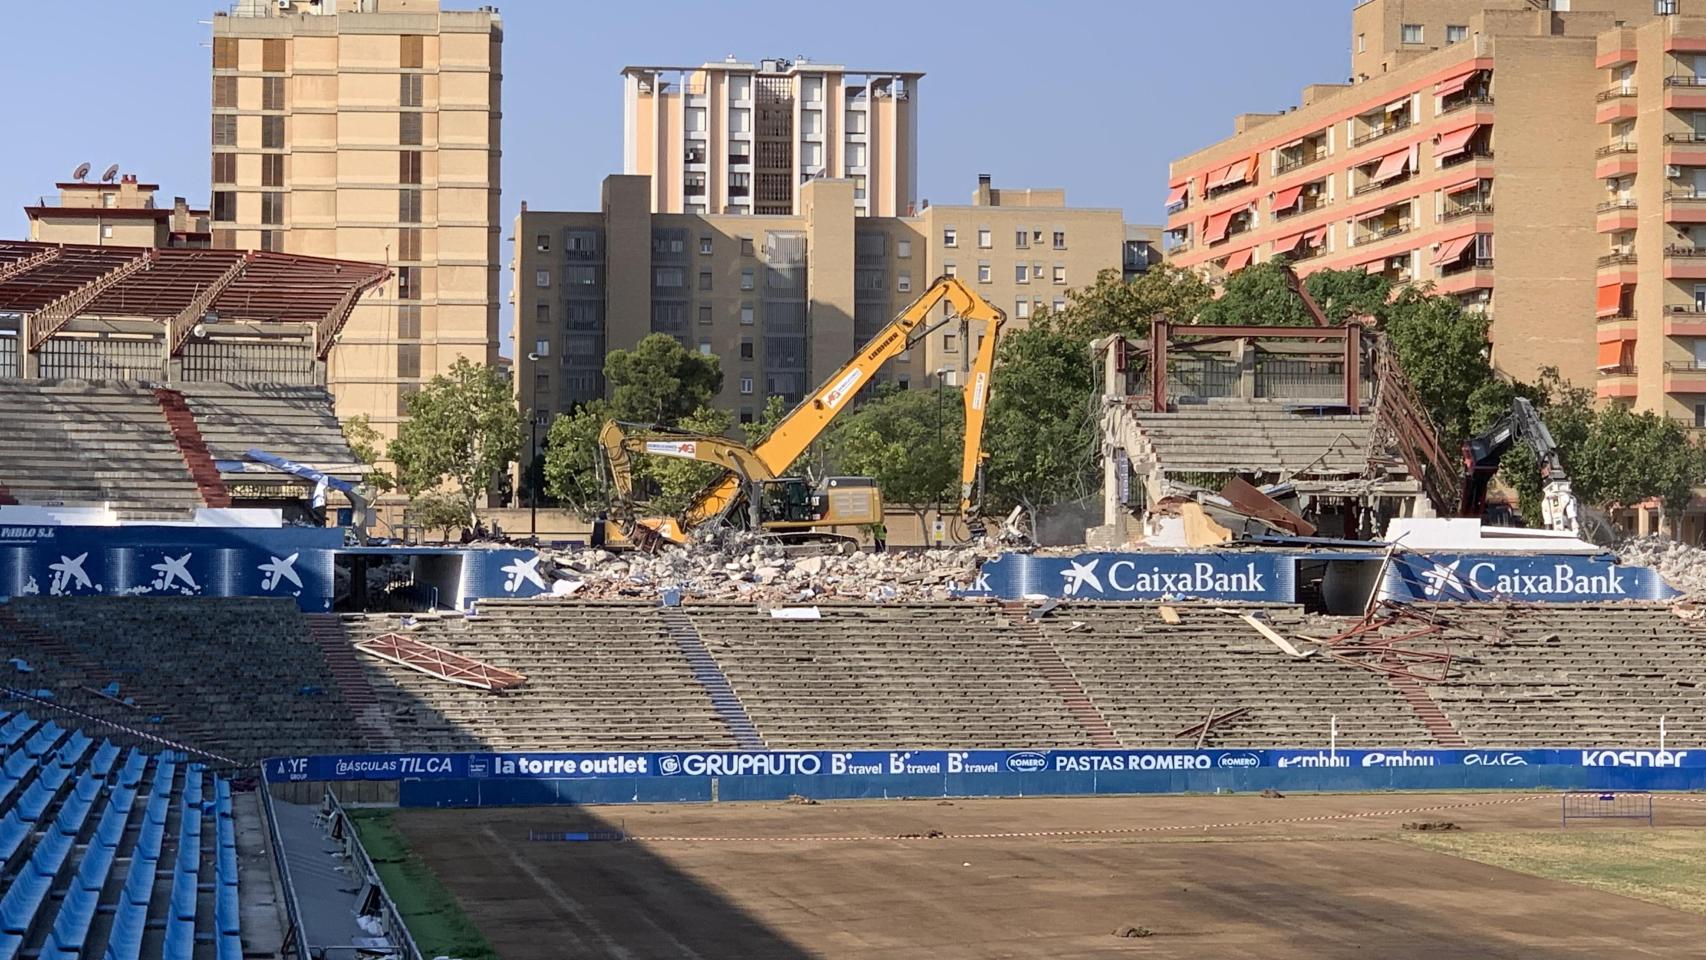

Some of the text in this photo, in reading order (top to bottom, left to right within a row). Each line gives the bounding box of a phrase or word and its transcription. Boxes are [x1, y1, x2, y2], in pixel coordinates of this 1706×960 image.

[1107, 560, 1266, 593] CaixaBank
[1468, 562, 1626, 595] CaixaBank
[399, 757, 453, 773] TILCA
[495, 756, 515, 774] la
[518, 757, 577, 774] torre
[580, 755, 648, 774] outlet
[683, 754, 821, 775] GRUPAUTO
[849, 763, 882, 774] travel
[907, 762, 940, 773] travel
[965, 762, 998, 773] travel
[1010, 758, 1045, 767] ROMERO
[1056, 755, 1211, 771] PASTAS ROMERO
[1221, 757, 1257, 767] ROMERO
